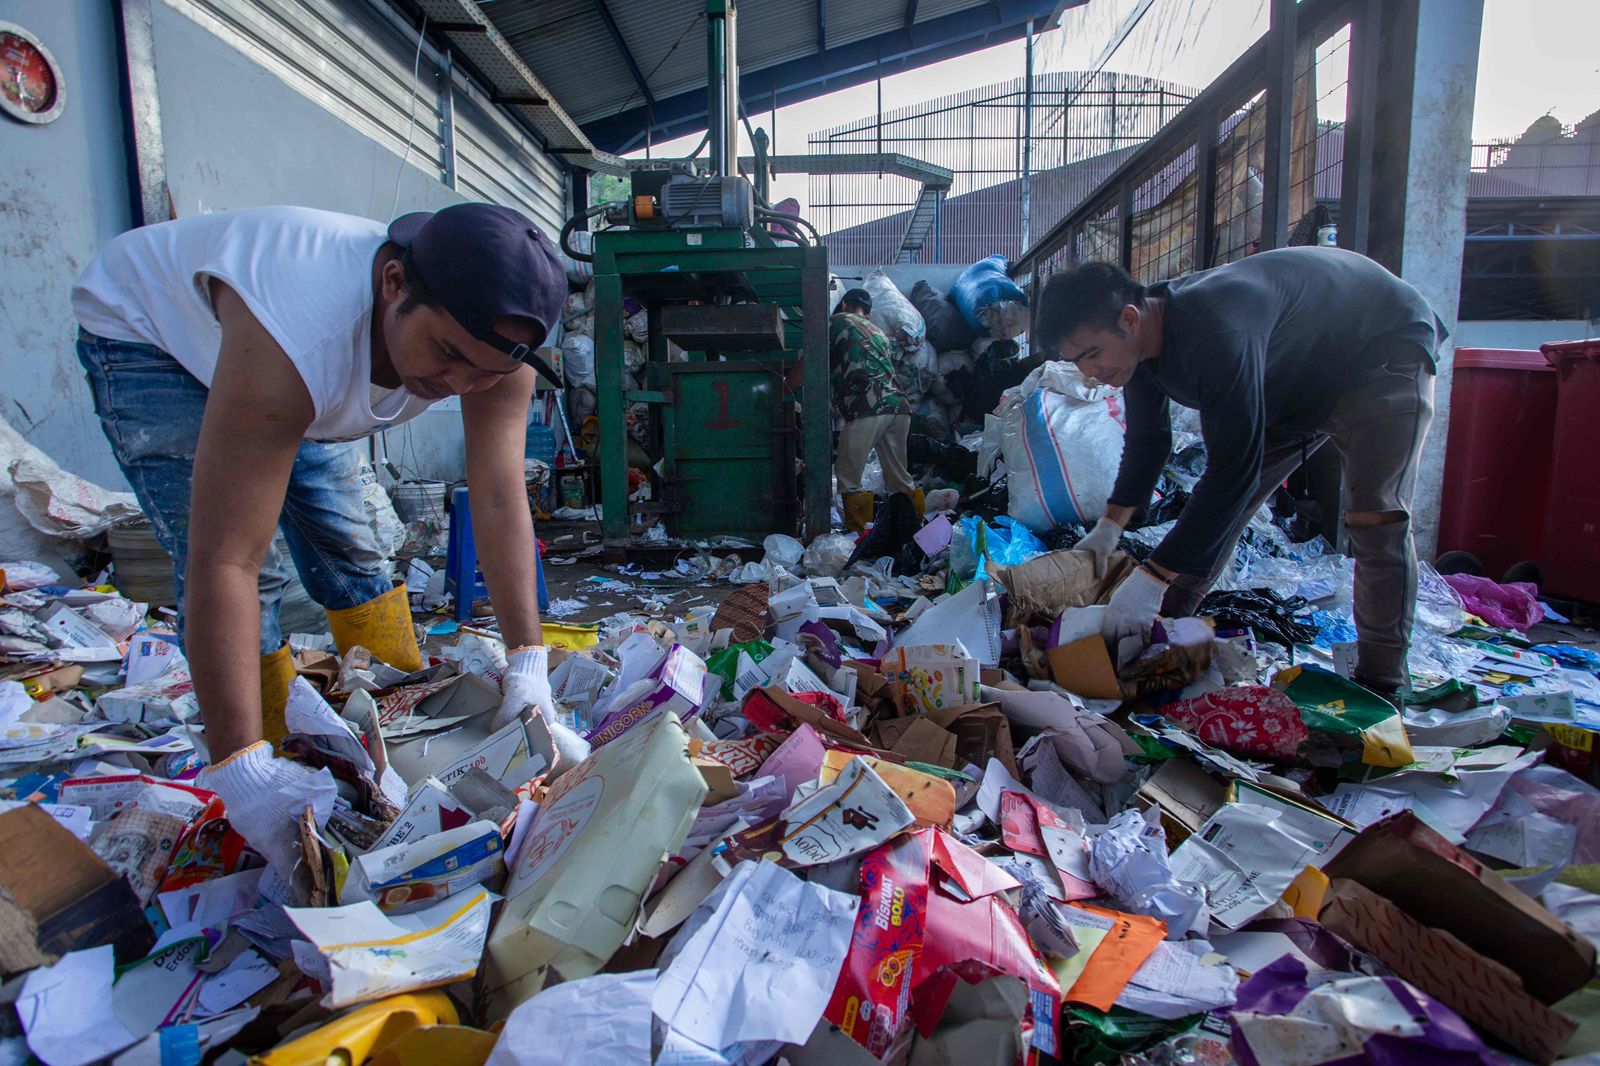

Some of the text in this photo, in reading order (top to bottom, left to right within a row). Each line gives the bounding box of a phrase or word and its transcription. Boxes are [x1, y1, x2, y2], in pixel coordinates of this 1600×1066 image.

[703, 380, 741, 429] 1
[591, 701, 651, 748] UNICORN
[891, 886, 906, 927] BOLU
